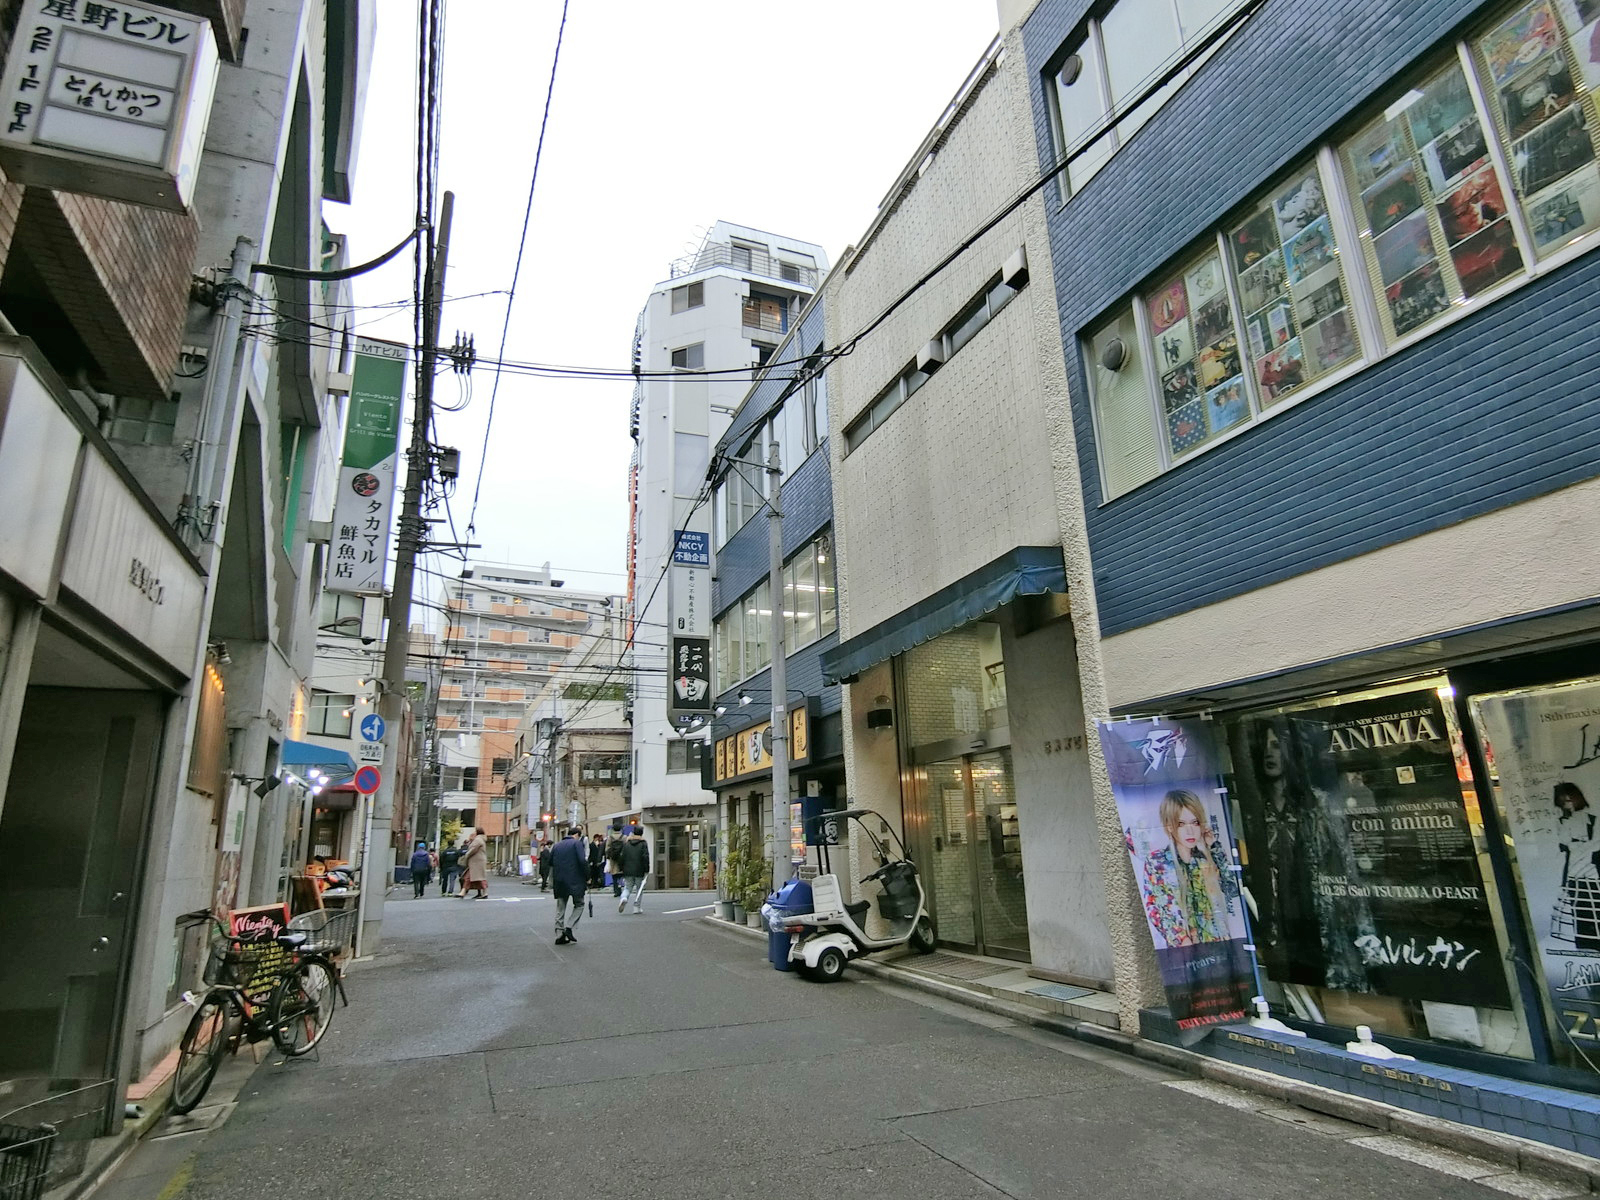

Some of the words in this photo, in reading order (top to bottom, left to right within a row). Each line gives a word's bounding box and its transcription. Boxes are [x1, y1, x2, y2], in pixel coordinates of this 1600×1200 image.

[40, 0, 190, 44] 星野ビル
[30, 26, 53, 53] 2F
[19, 64, 40, 91] 1F
[65, 75, 161, 108] とんかつ
[8, 101, 32, 133] B1F
[77, 95, 143, 117] はしの
[361, 343, 403, 358] MTビル
[360, 499, 383, 564] タカマル
[334, 524, 359, 579] 鮮魚店
[678, 541, 704, 551] NKCY
[1355, 717, 1373, 726] NEW
[1373, 712, 1399, 722] SINGLE
[1400, 707, 1434, 719] RELEASE
[1327, 716, 1441, 754] ANIMA
[1396, 801, 1432, 812] ONEMAN
[1433, 800, 1459, 810] TOUR
[1351, 818, 1386, 832] con
[1391, 812, 1456, 830] anima
[1373, 885, 1430, 898] TSUTAYA
[1432, 886, 1479, 900] O-EAST
